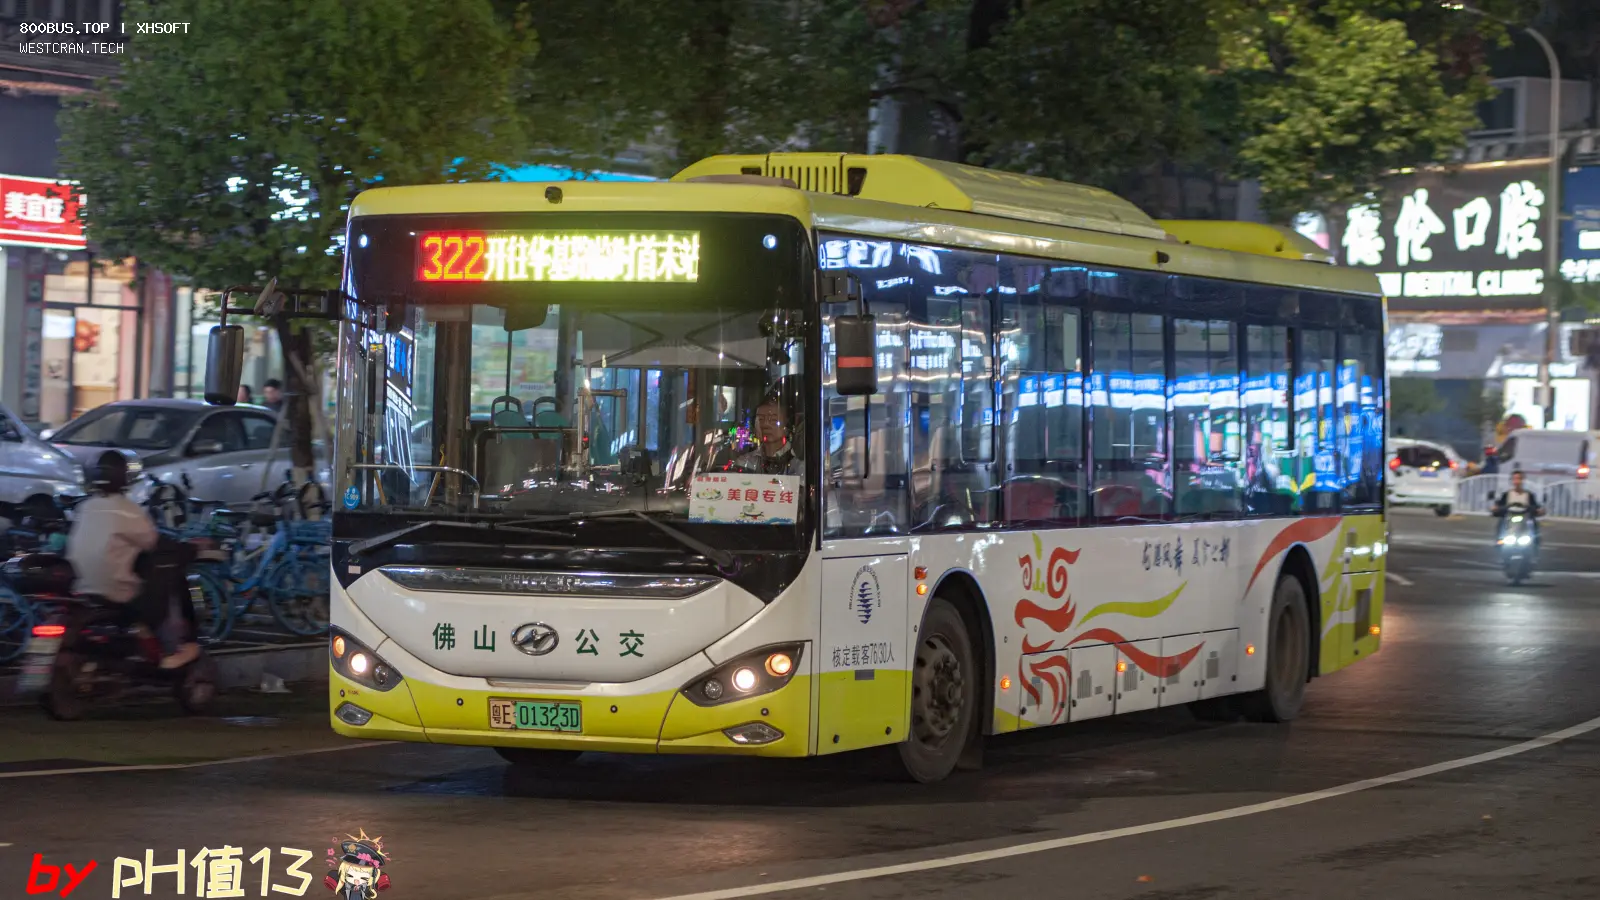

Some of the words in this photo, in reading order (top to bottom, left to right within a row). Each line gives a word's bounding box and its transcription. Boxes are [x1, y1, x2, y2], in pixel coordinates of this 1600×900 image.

[423, 236, 484, 280] 322
[727, 488, 794, 504] 美食专线
[432, 623, 496, 652] 佛山
[575, 629, 645, 658] 公交
